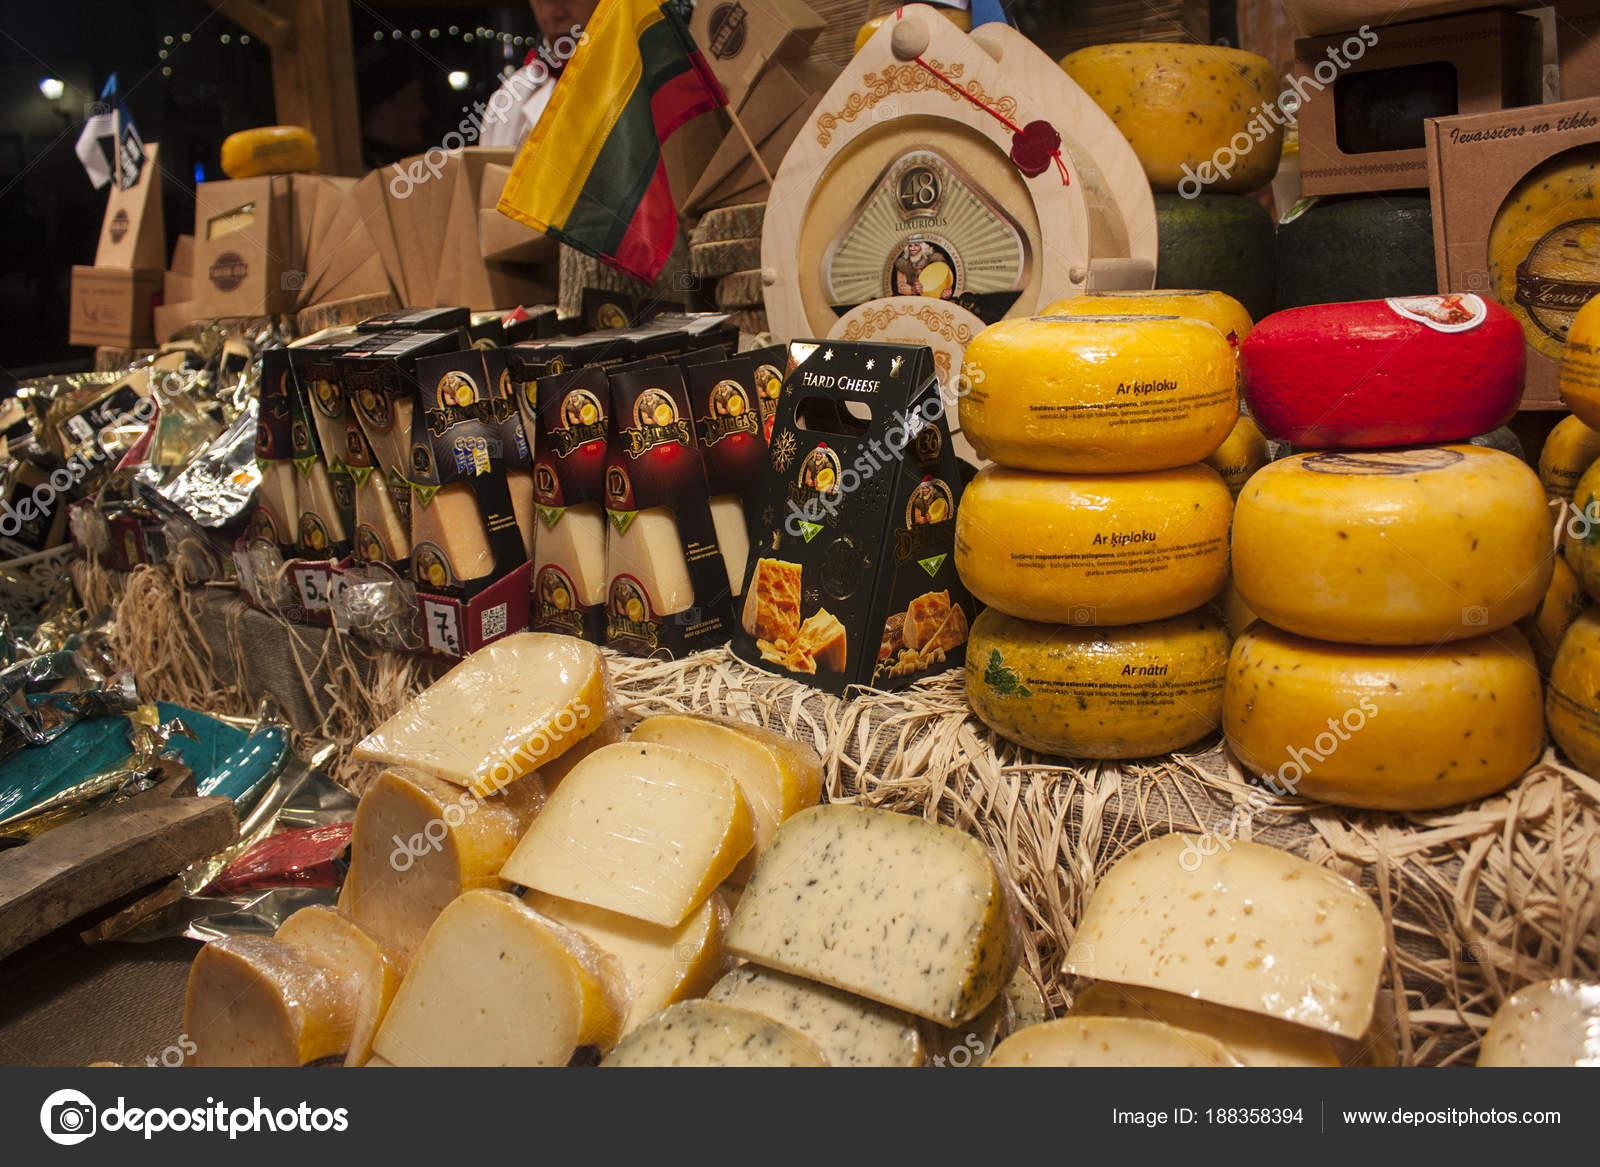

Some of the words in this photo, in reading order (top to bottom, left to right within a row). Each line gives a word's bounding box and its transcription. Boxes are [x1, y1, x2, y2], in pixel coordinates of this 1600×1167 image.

[1532, 122, 1549, 134] no
[1557, 110, 1597, 131] tikko
[901, 172, 936, 205] 48
[895, 217, 948, 232] LUXURIOUS
[802, 372, 835, 388] HARD
[837, 376, 881, 393] CHEESE
[1116, 383, 1131, 395] Ar
[1133, 379, 1177, 397] ķiploku
[536, 471, 551, 491] 12
[609, 471, 622, 491] 12
[1093, 533, 1109, 545] Ar
[1111, 529, 1156, 547] ķiploku
[1121, 664, 1137, 676] Ar
[1138, 663, 1168, 676] nātri
